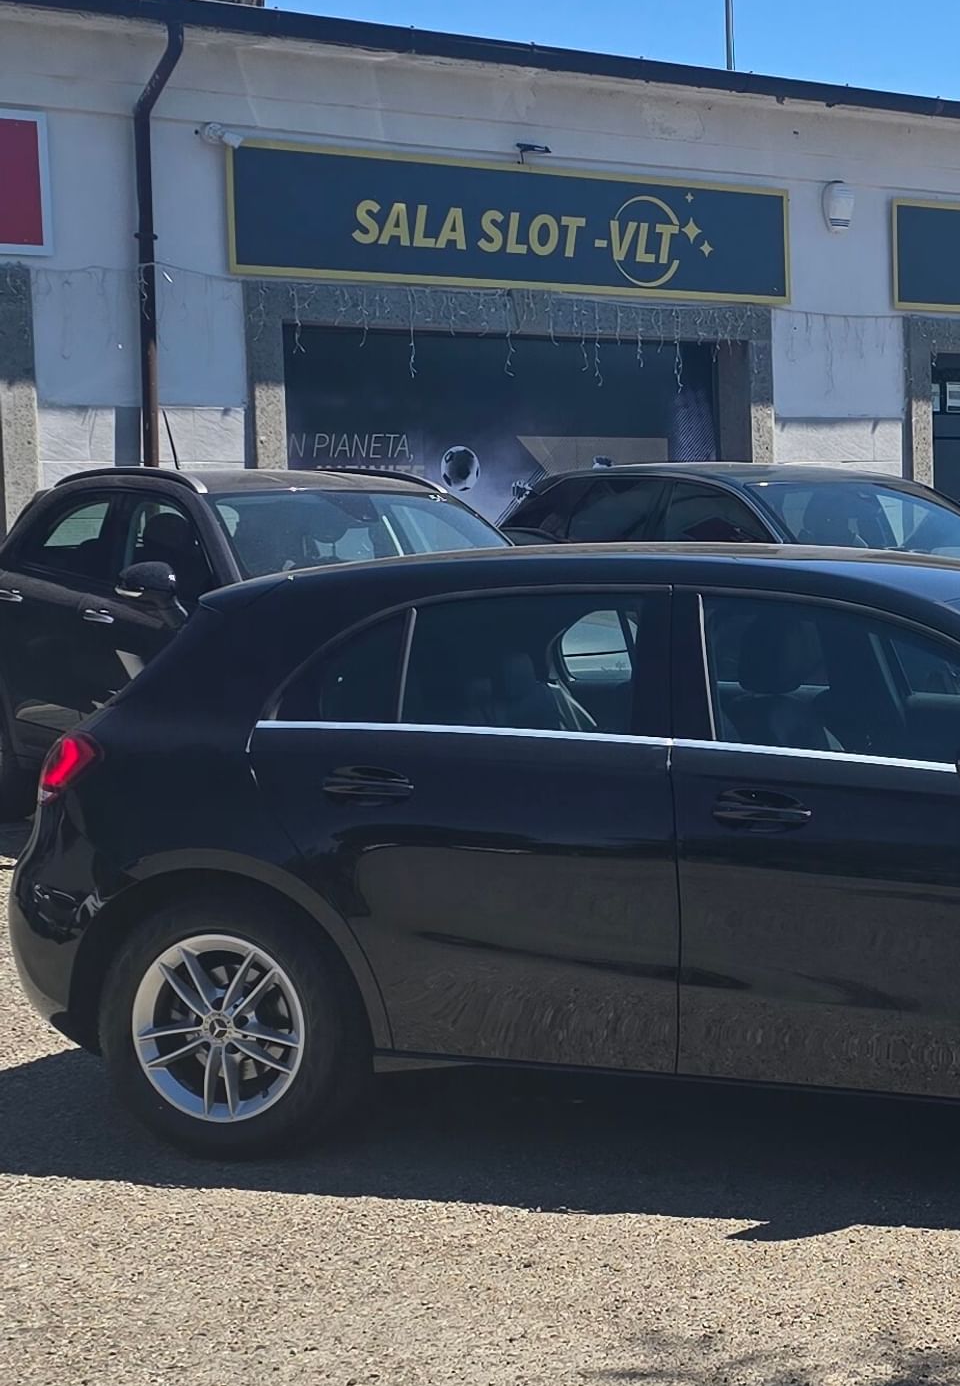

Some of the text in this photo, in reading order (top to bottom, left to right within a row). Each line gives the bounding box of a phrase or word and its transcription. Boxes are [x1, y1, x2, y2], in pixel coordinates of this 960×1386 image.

[352, 199, 467, 250] SALA
[477, 210, 586, 258] SLOT
[312, 433, 415, 462] PIANETA,
